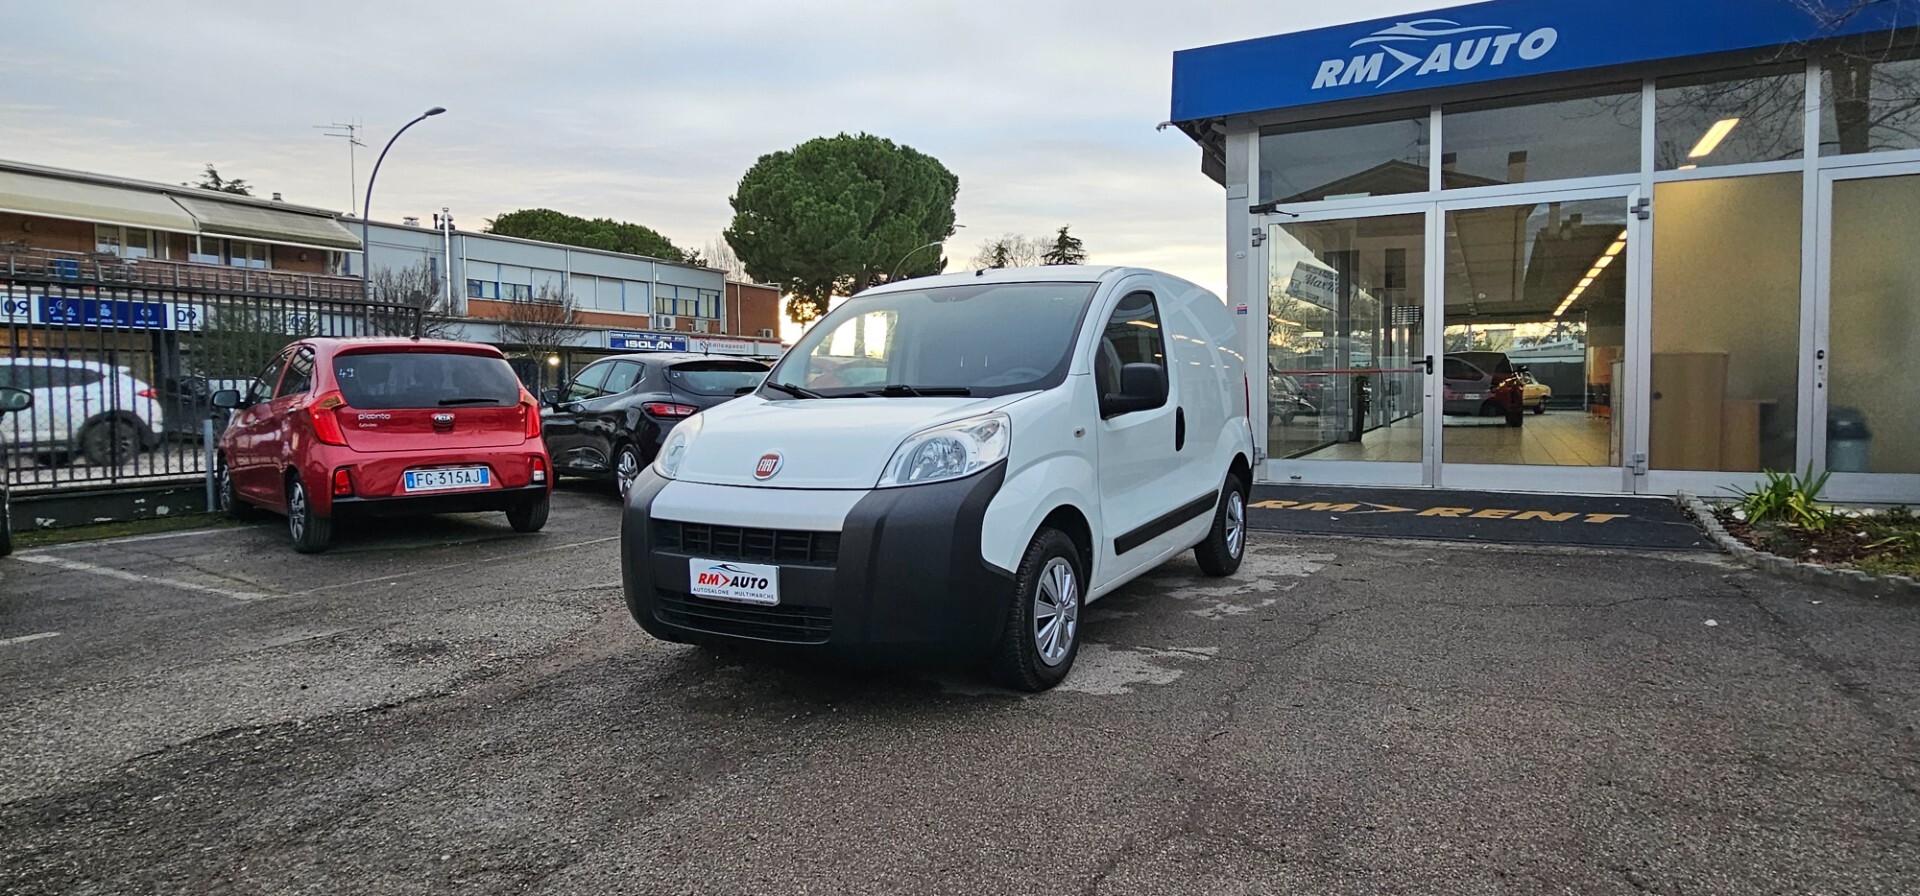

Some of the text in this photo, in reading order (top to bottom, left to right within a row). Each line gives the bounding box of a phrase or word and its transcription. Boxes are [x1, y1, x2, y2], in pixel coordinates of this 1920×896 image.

[1311, 27, 1558, 90] RM AUTO
[625, 340, 673, 350] ISOLAN
[358, 412, 391, 421] picanto
[757, 458, 777, 472] FIAT
[1247, 499, 1631, 524] RM RENT
[698, 573, 768, 590] RM AUTO
[693, 587, 774, 599] AUTOSALONE MULTIMARCHE
